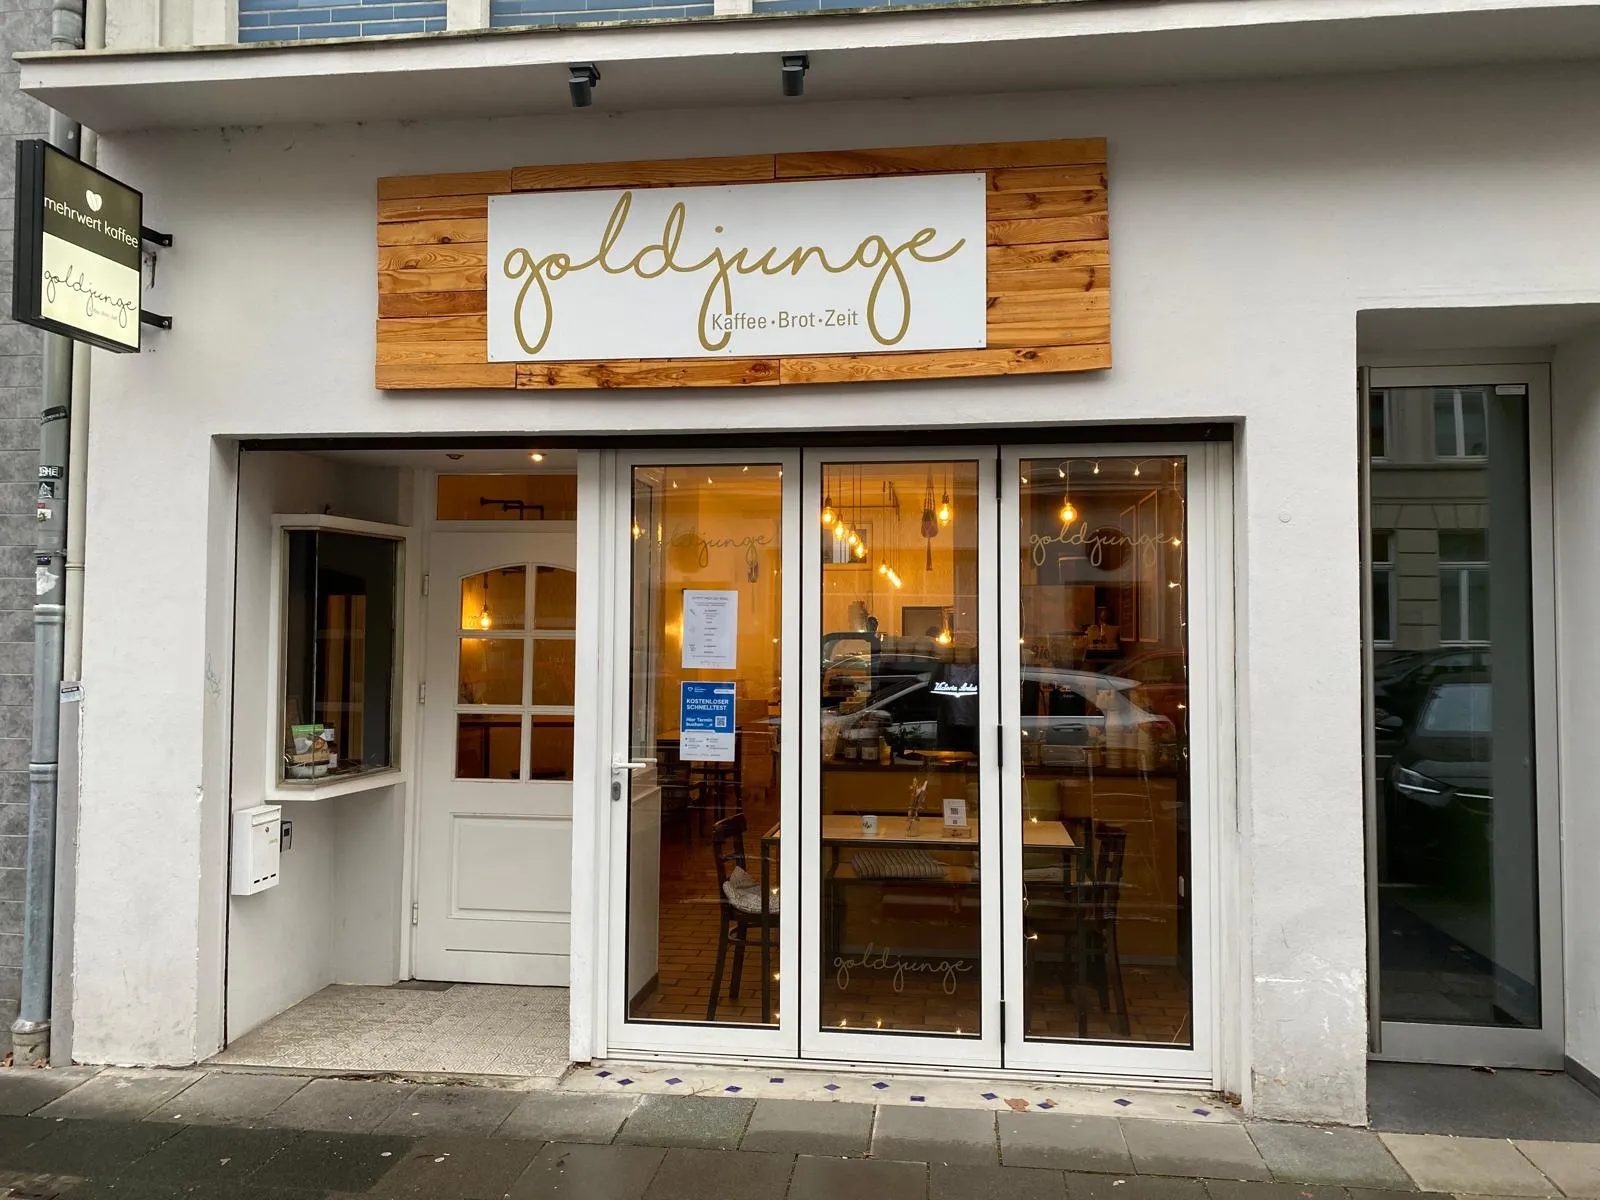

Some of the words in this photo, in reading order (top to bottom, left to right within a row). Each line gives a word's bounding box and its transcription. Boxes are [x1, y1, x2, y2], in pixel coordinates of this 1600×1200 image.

[44, 197, 102, 232] mehrwert
[104, 220, 139, 249] kaffee
[44, 264, 137, 328] goldjunge
[504, 191, 966, 354] goldjunge
[712, 312, 767, 330] Kaffee
[778, 311, 815, 328] Brot
[825, 308, 859, 327] Zeit
[1029, 520, 1178, 567] goldjunge
[834, 942, 973, 995] goldjunge
